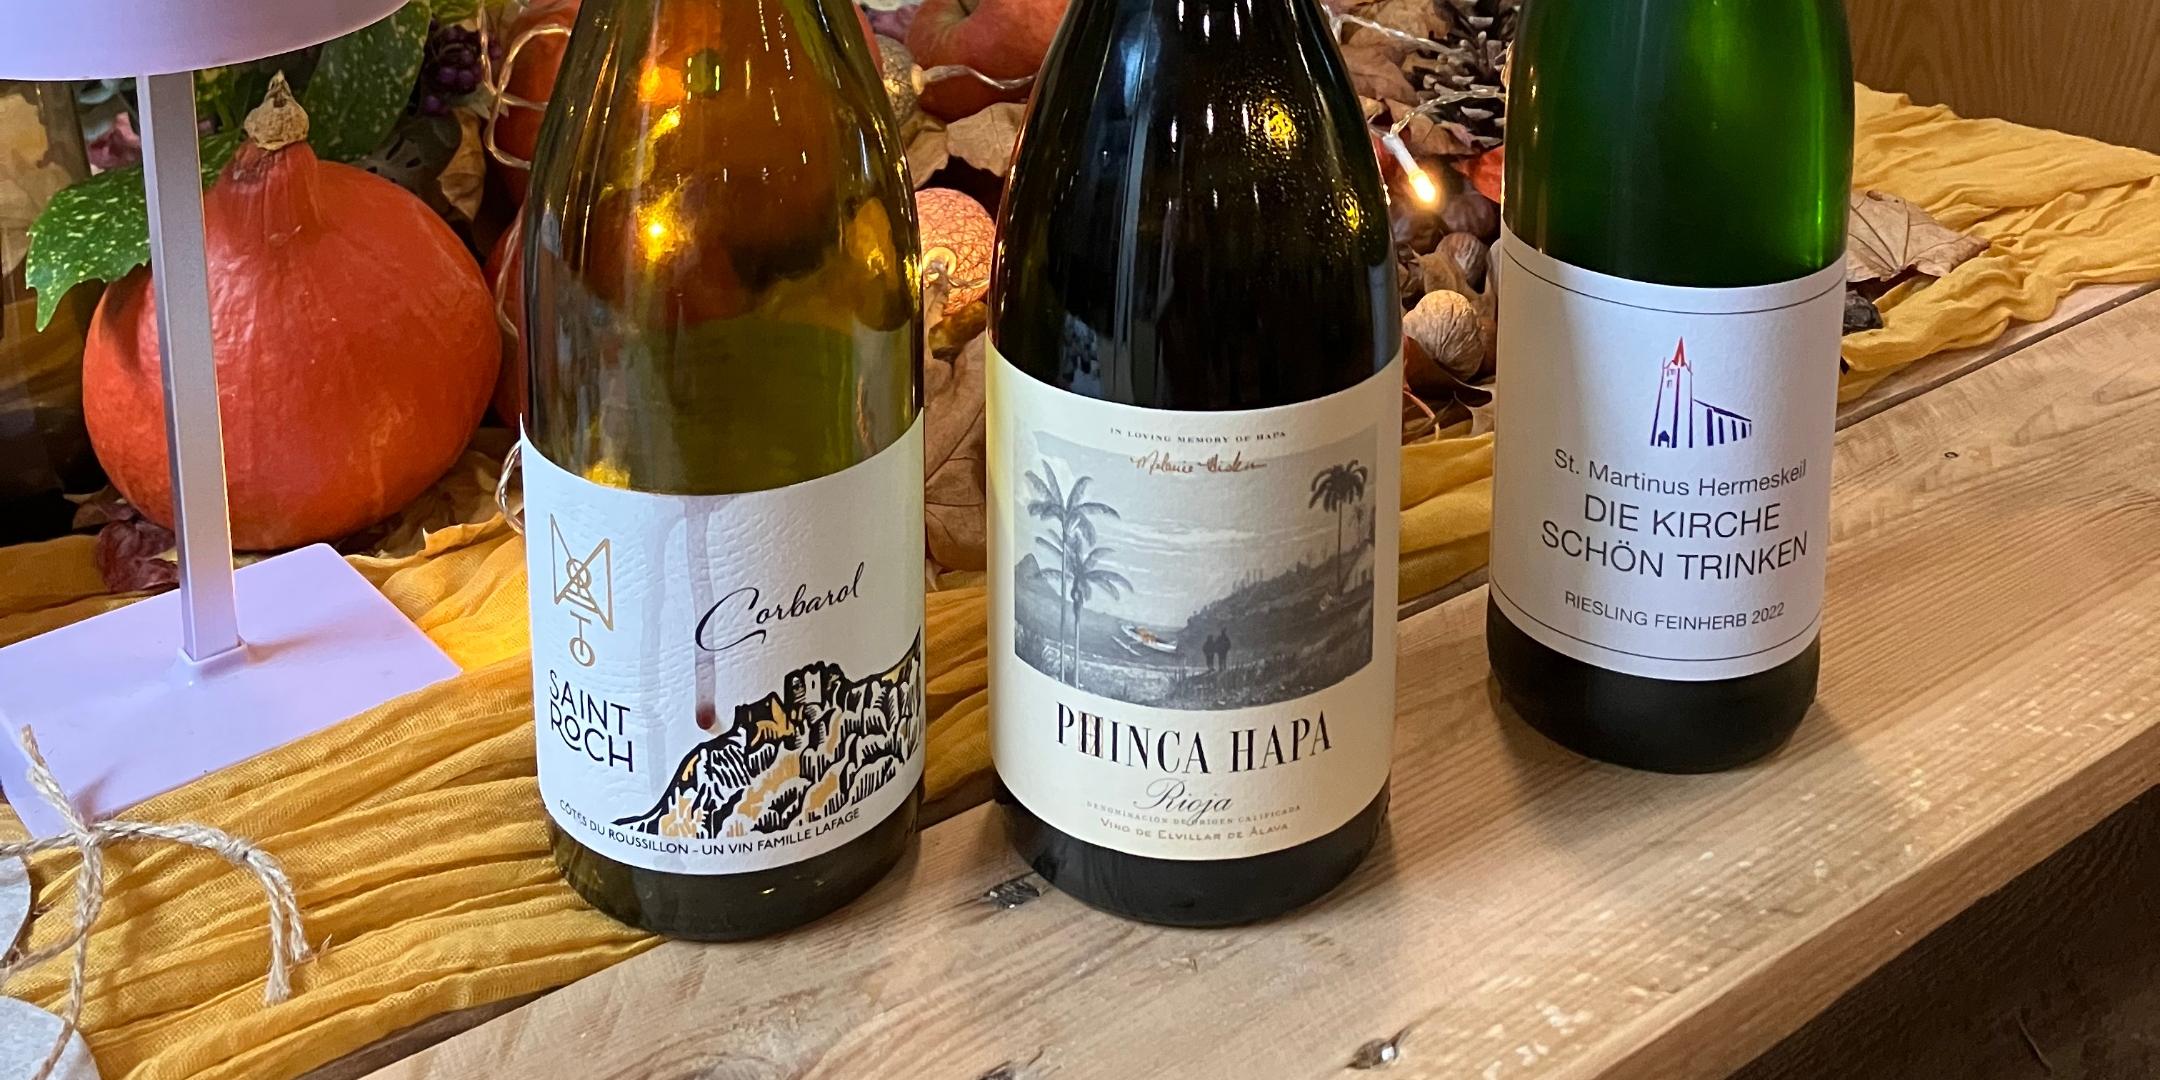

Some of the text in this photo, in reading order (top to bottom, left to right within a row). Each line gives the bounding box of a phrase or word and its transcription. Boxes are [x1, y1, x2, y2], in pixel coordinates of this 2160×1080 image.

[1110, 427, 1286, 444] IN LOVING MEMORY OF HAPA
[1554, 448, 1807, 496] St. Martinus Hermeskeil
[1584, 493, 1782, 539] DIE KIRCHE
[1541, 519, 1808, 580] SCHÖN TRINKEN
[694, 561, 866, 652] Corbarol
[1564, 590, 1786, 631] RIESLING FEINHERB 2022
[549, 668, 631, 736] SAINT
[549, 698, 634, 773] ROCH
[1056, 701, 1332, 775] PHINCA HAPA
[559, 798, 587, 827] CÔTES
[589, 820, 606, 837] DU
[608, 829, 689, 855] ROUSSILLON
[702, 845, 724, 856] UN
[729, 843, 753, 855] VIN
[757, 830, 812, 852] FAMILLE
[815, 807, 860, 837] LAFAGE
[1132, 777, 1234, 827] Rioja
[1173, 817, 1187, 825] DE
[1238, 804, 1301, 823] CALIFICADA
